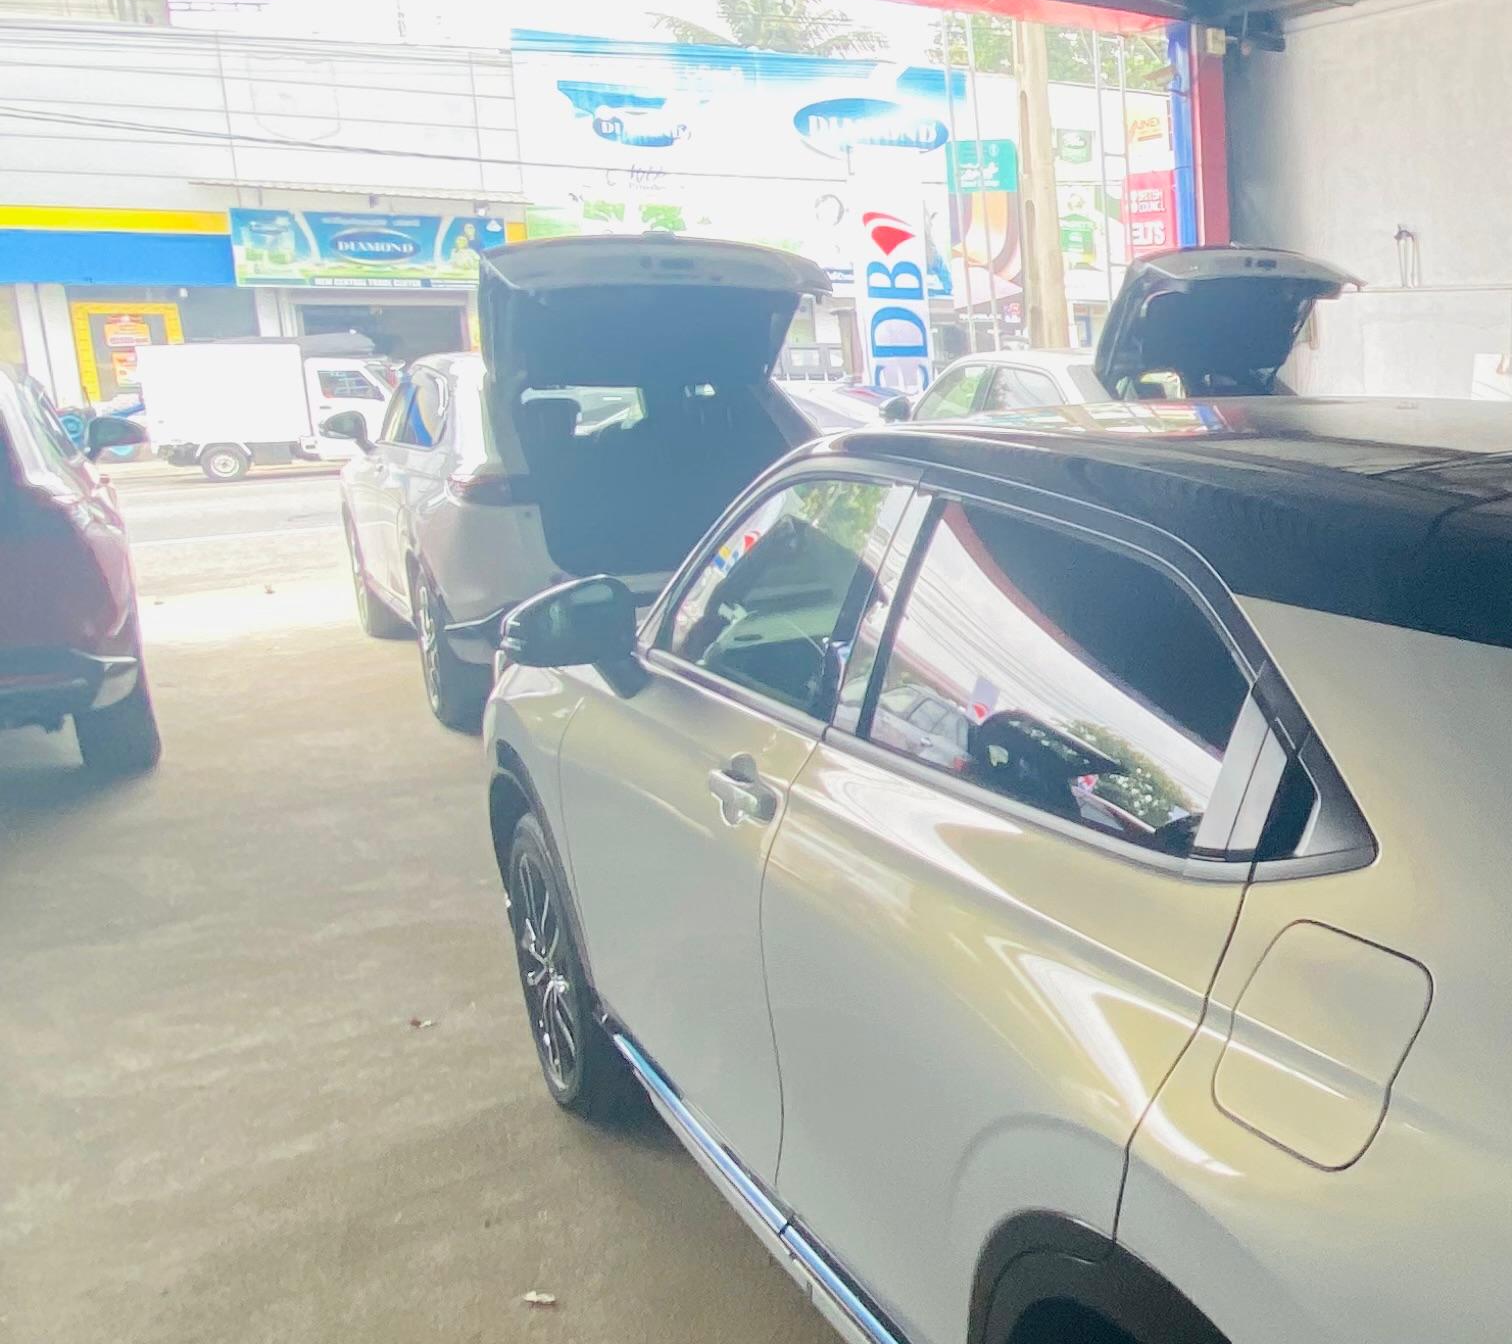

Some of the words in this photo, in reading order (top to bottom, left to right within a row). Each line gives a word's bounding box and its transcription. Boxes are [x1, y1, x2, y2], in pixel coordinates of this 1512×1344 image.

[808, 115, 938, 144] DIAOND
[1127, 221, 1166, 246] ELTS
[338, 240, 413, 253] DIAMOND
